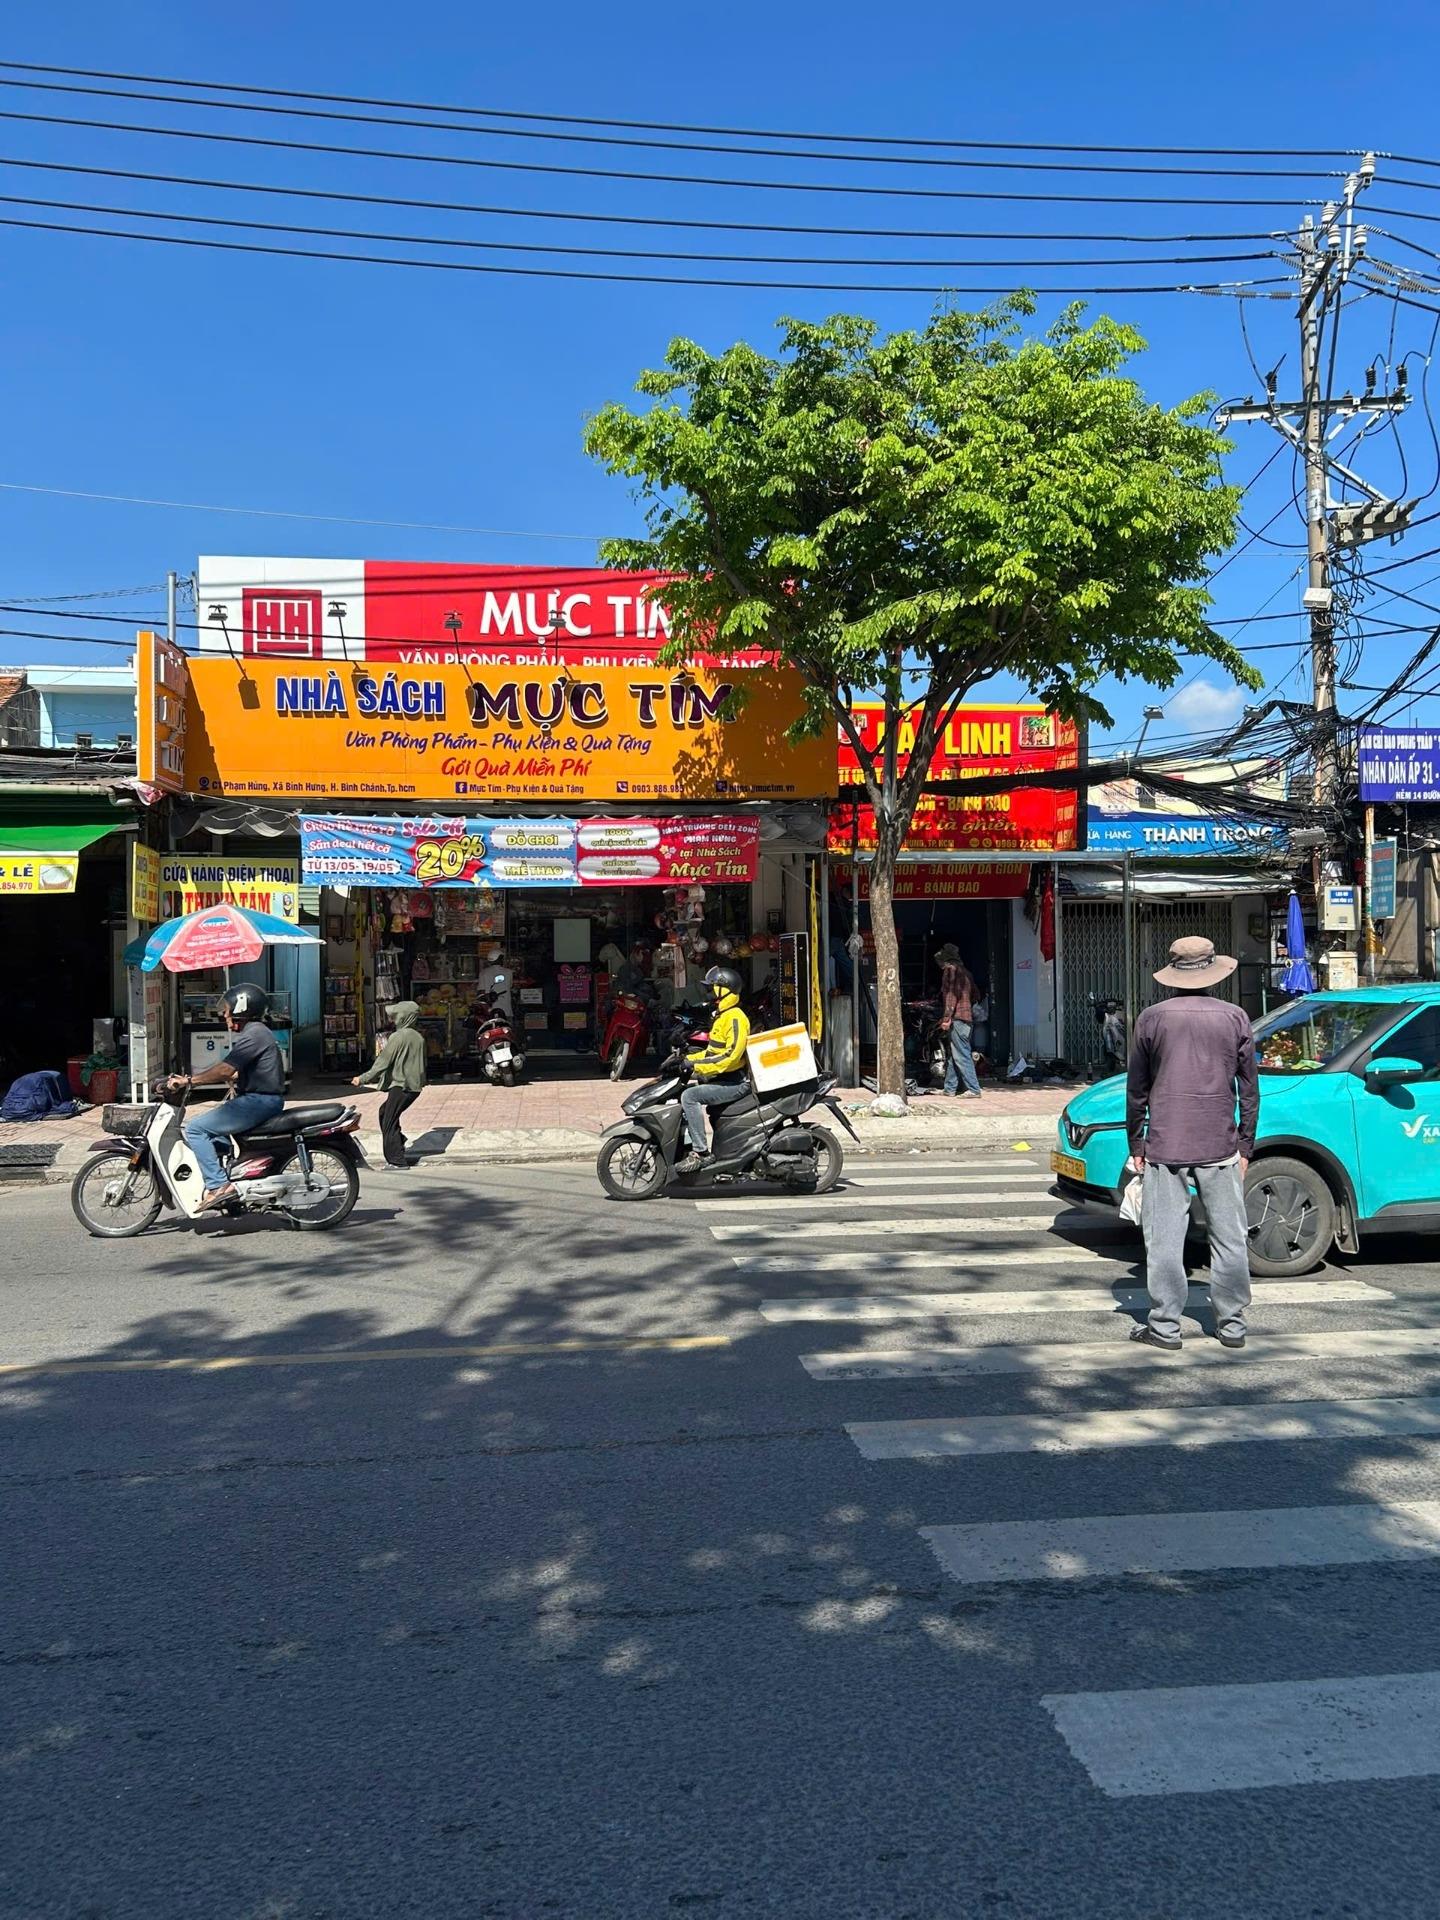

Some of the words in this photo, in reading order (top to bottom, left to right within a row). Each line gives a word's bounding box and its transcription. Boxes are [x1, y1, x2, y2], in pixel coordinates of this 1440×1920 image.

[480, 589, 592, 645] MỰC
[444, 649, 510, 666] PHÒNG
[276, 671, 347, 712] NHÀ
[357, 672, 446, 714] SÁCH
[471, 677, 609, 732] MỰC
[629, 671, 737, 724] TÍM
[346, 731, 376, 747] Văn
[380, 731, 428, 754] Phòng
[432, 731, 477, 749] Phẩm
[492, 733, 522, 753] Phụ
[526, 733, 560, 753] Kiện
[563, 736, 578, 751] &
[581, 734, 613, 753] Quà
[617, 734, 652, 755] Tặng
[945, 722, 1011, 755] LINH
[474, 757, 510, 779] Quà
[513, 757, 555, 777] Miễn
[559, 758, 592, 777] Phí
[1363, 755, 1386, 784] NHÂN
[1389, 755, 1406, 784] DÂN
[1408, 752, 1420, 784] ẤP
[1422, 762, 1433, 784] 31
[224, 781, 246, 792] Phạm
[330, 783, 339, 792] H.
[469, 784, 485, 795] Mực
[488, 784, 501, 793] Tím
[507, 784, 521, 795] Phụ
[523, 784, 539, 795] Kiện
[542, 784, 548, 793] &
[550, 784, 564, 793] Quà
[1396, 788, 1411, 800] HẺM
[1413, 791, 1422, 800] 14
[402, 819, 438, 838] Sale
[441, 816, 466, 836] off
[1142, 824, 1205, 843] THÀNH
[309, 840, 330, 851] Săn
[506, 829, 526, 846] ĐỒ
[528, 834, 558, 846] CHƠI
[416, 835, 485, 880] 20%
[680, 848, 693, 859] tại
[697, 848, 716, 857] Nhà
[718, 847, 741, 857] Sách
[13, 864, 34, 877] LẺ
[163, 861, 188, 882] CỬA
[191, 862, 224, 882] HÀNG
[228, 864, 256, 885] ĐIỆN
[259, 867, 294, 886] THOẠI
[307, 860, 322, 870] TỪ
[505, 860, 528, 876] THỂ
[530, 865, 563, 876] THAO
[669, 862, 711, 881] Mực
[714, 860, 748, 876] Tím
[947, 863, 974, 876] QUAY
[957, 881, 980, 894] BAO
[239, 886, 271, 915] TÂM
[206, 1040, 215, 1051] 8
